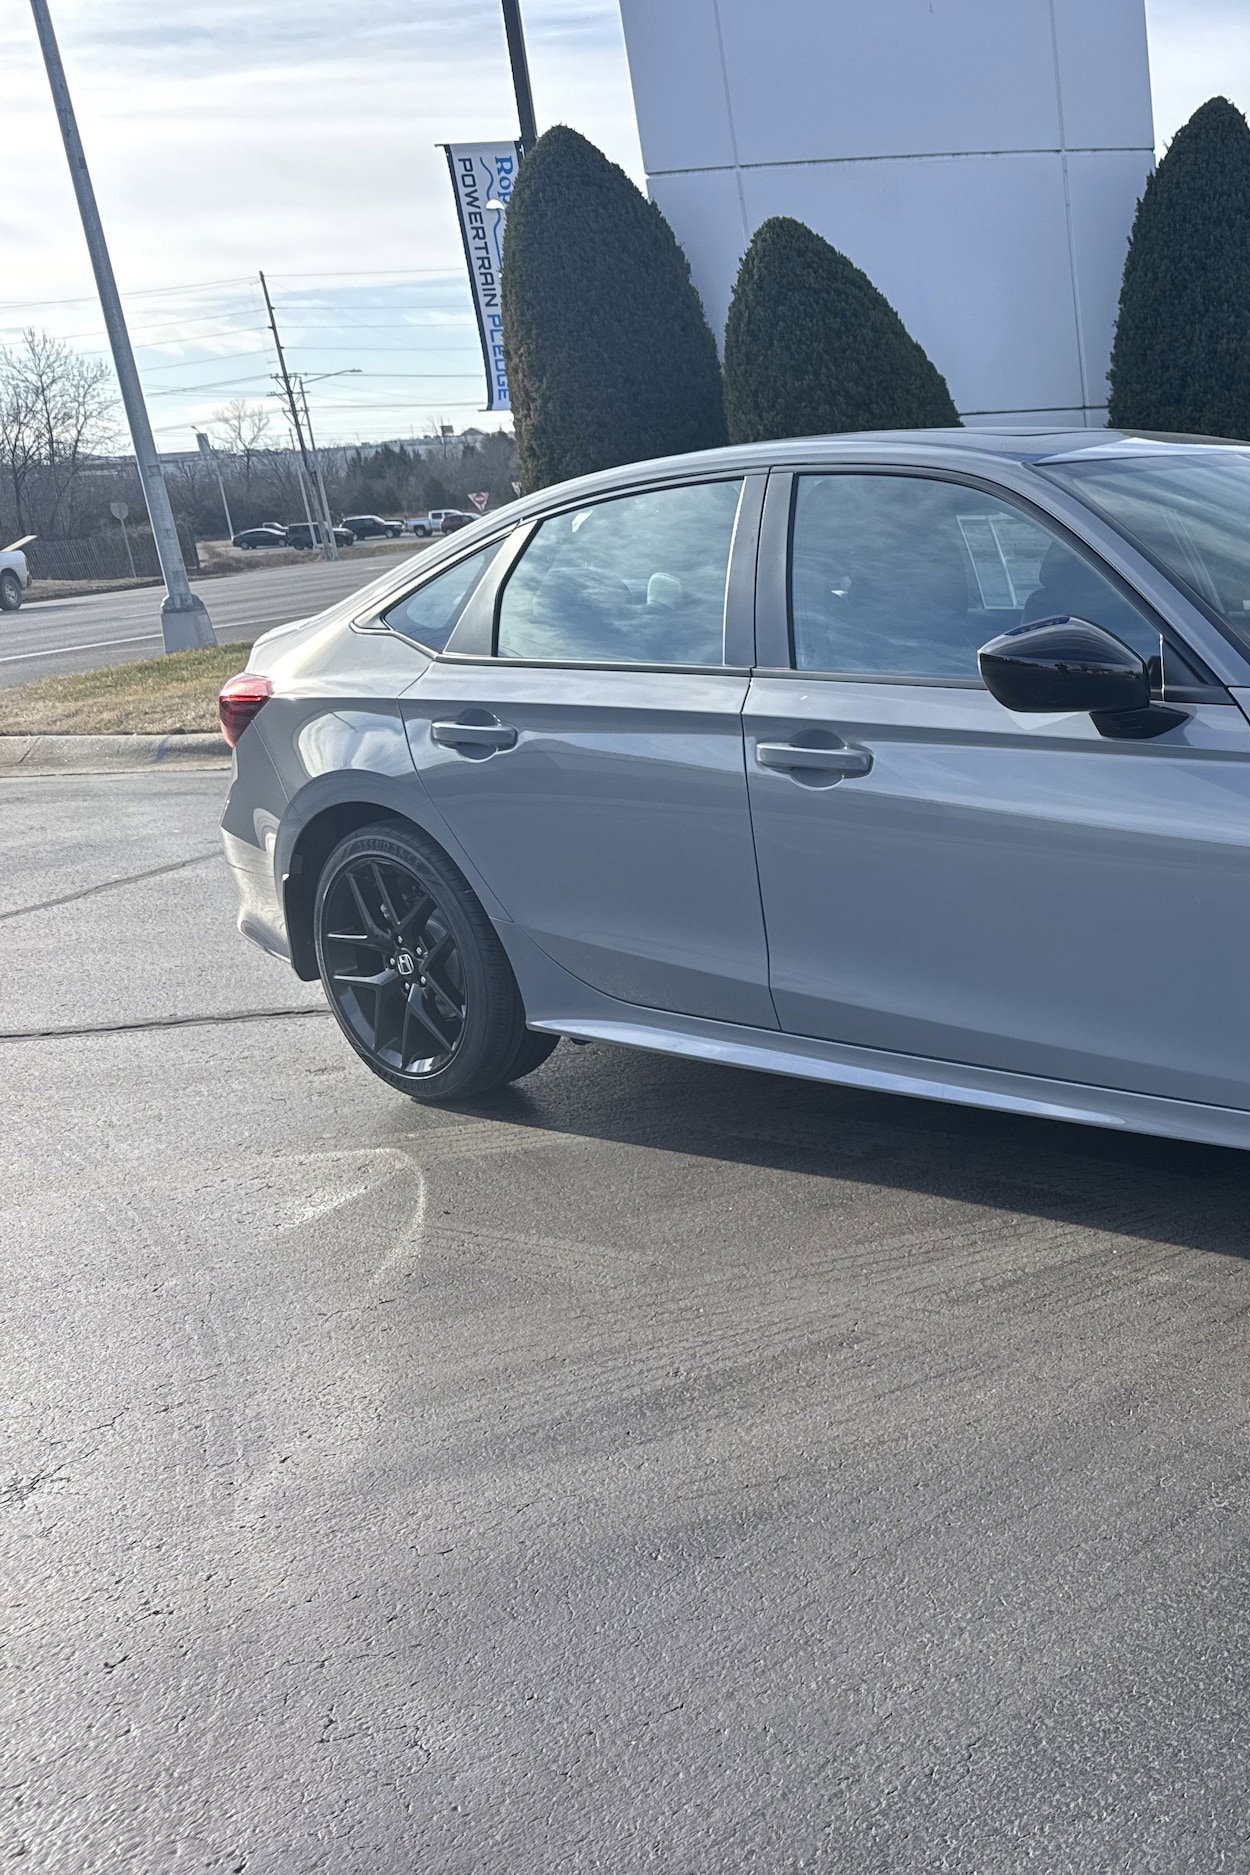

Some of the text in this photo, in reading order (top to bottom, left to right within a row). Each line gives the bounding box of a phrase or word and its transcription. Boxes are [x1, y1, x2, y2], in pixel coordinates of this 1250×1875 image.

[495, 156, 514, 206] Rop
[458, 157, 509, 402] POWERTRAIN PLEDGE
